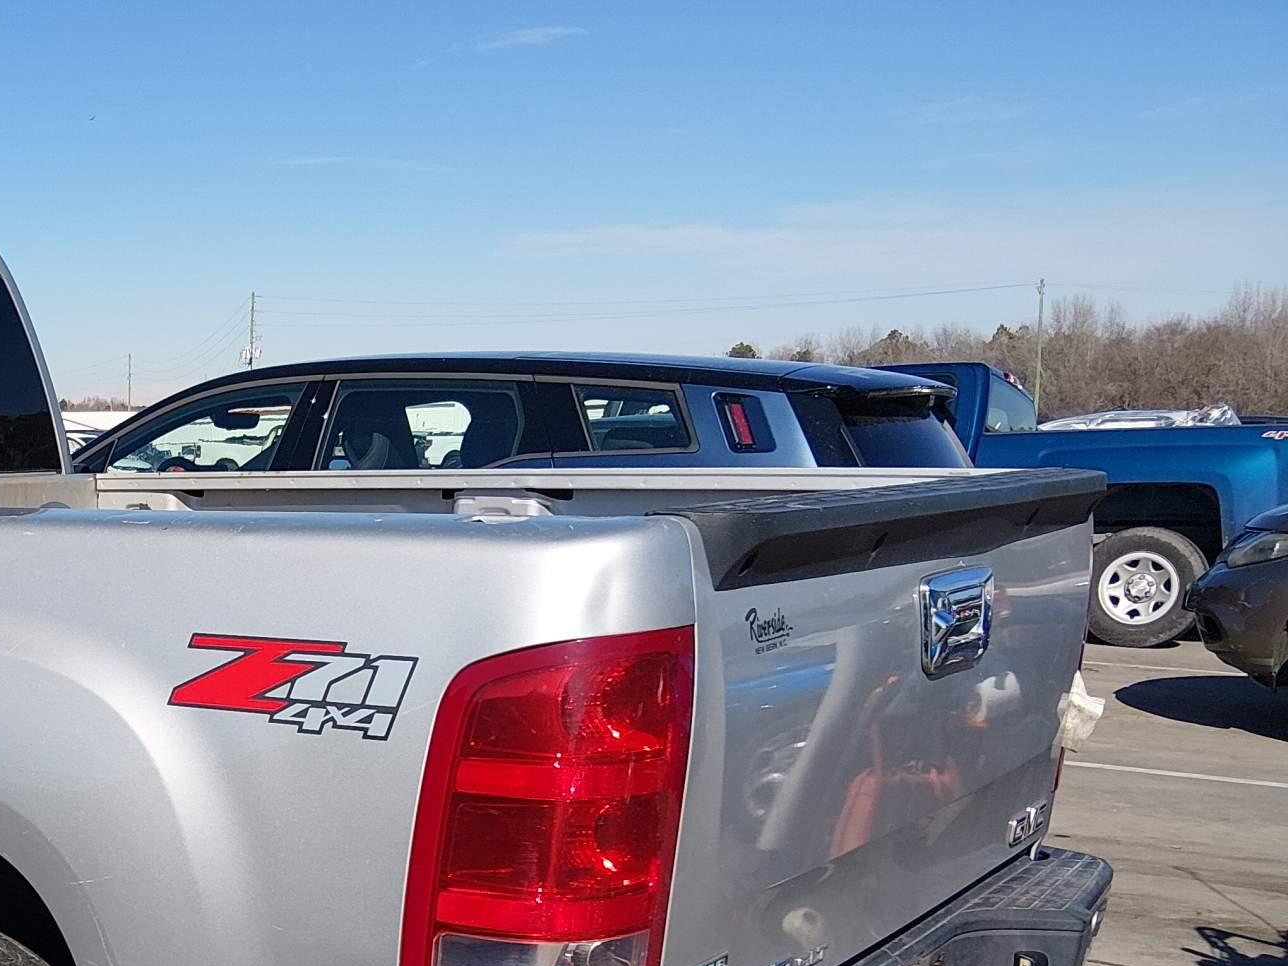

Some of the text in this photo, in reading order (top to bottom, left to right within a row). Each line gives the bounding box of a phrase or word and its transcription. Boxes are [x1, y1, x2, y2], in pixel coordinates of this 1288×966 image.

[745, 607, 793, 643] Riverside
[167, 632, 419, 715] Z71
[1007, 801, 1047, 848] GMC
